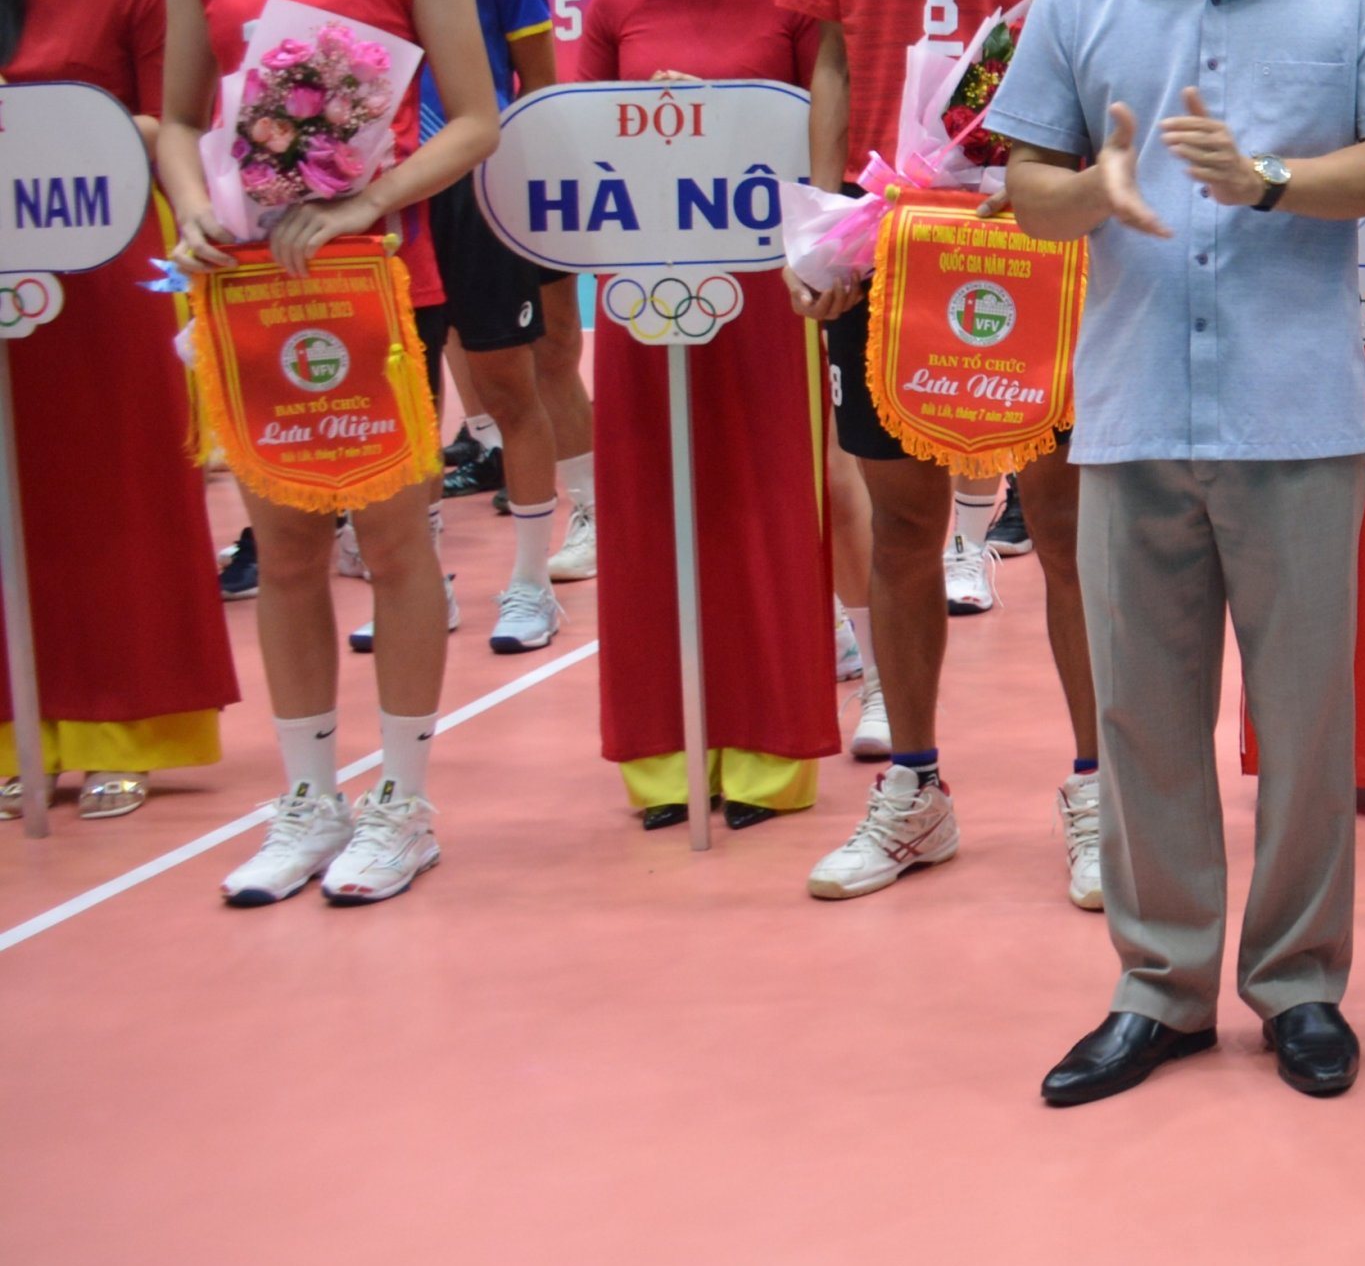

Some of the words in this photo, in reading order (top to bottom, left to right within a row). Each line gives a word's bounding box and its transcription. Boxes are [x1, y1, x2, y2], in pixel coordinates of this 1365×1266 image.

[617, 90, 706, 146] ĐỘI
[13, 175, 112, 230] NAM
[527, 161, 640, 232] HÀ
[677, 162, 810, 246] NỘ
[939, 247, 966, 273] QUỐC
[967, 254, 982, 273] GIA
[984, 253, 1005, 276] NĂM
[1007, 259, 1032, 279] 2023
[975, 317, 1000, 332] VFV
[310, 364, 336, 377] VFV
[928, 353, 957, 368] BAN
[962, 353, 982, 370] TỔ
[985, 357, 1027, 374] CHỨC
[903, 368, 960, 396] Lưu
[966, 373, 1045, 407] Niệm
[274, 402, 306, 417] BAN
[331, 395, 371, 412] CHỨC
[979, 409, 985, 421] 7
[1002, 411, 1024, 424] 2023
[256, 421, 315, 445] Lưu
[318, 414, 398, 442] Niệm
